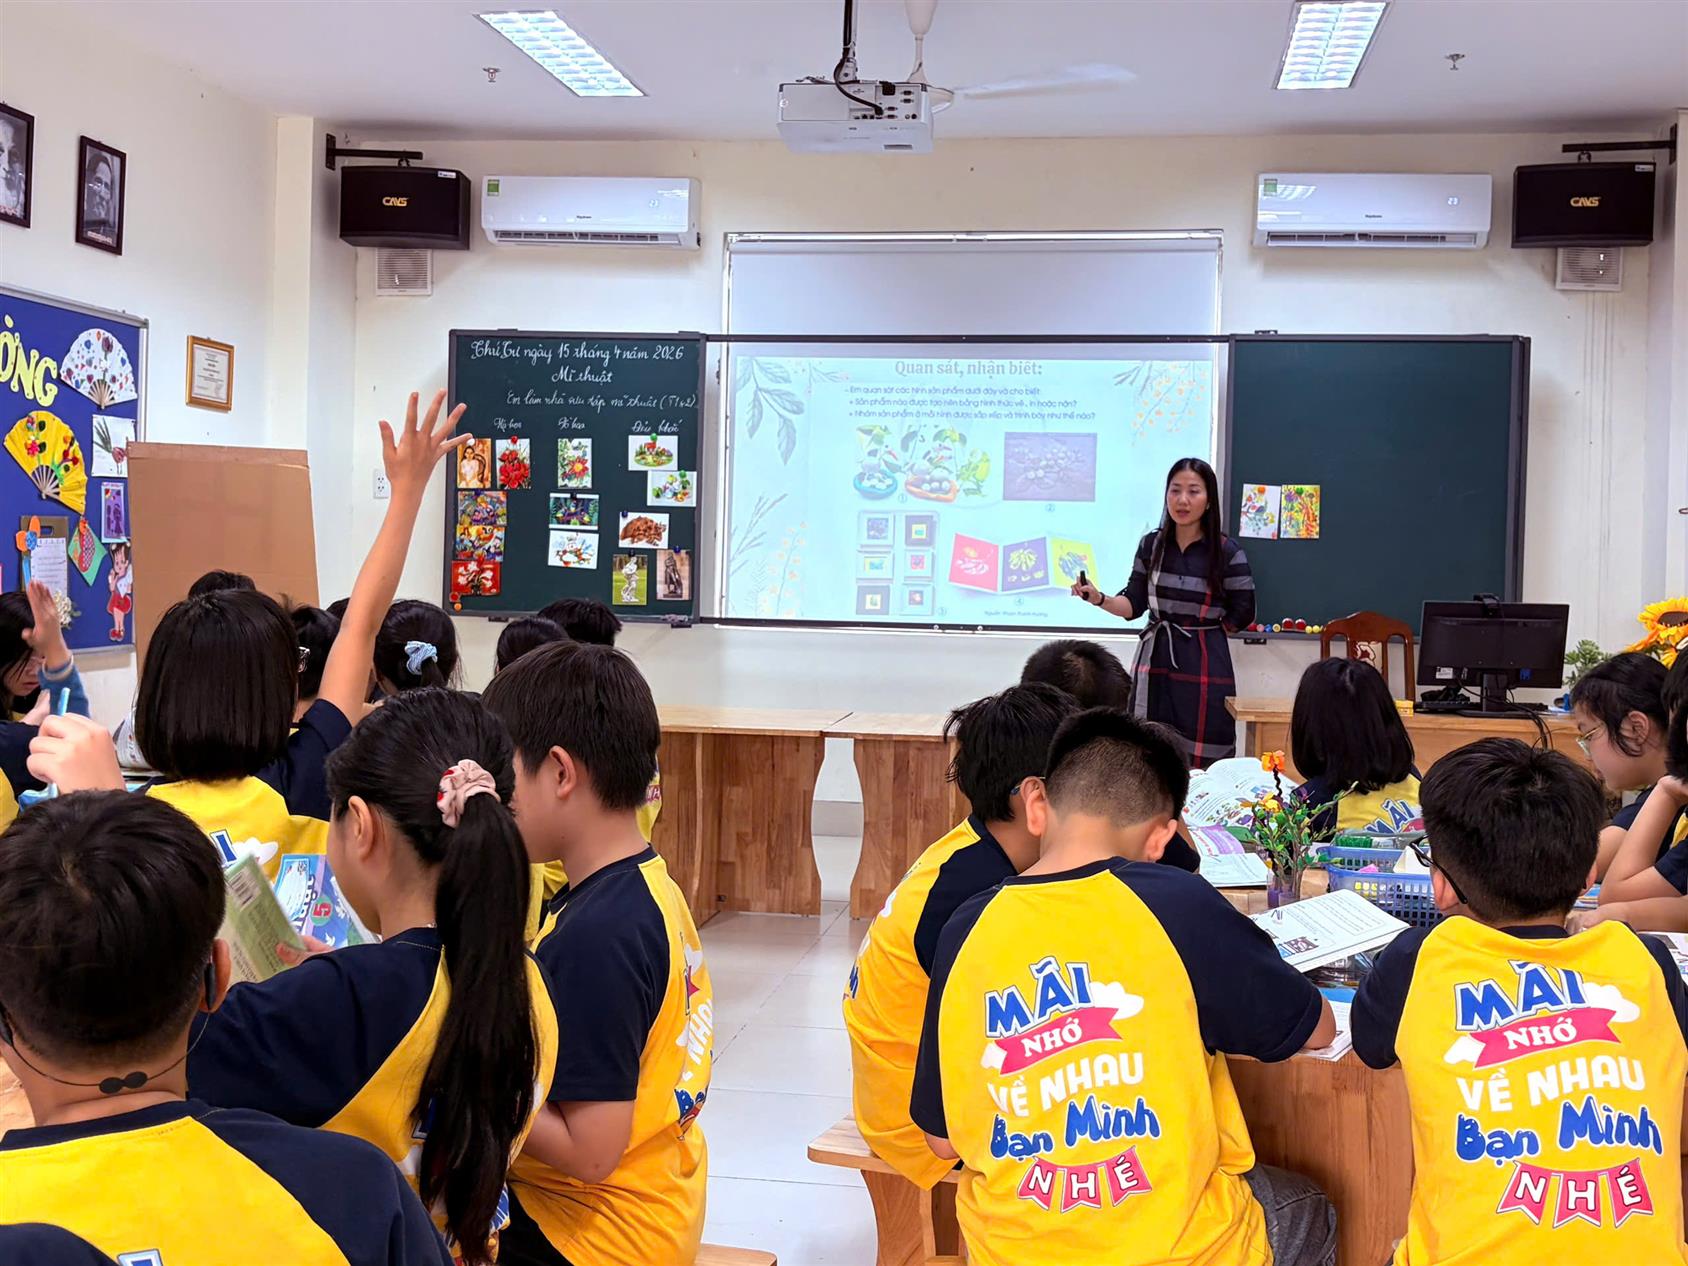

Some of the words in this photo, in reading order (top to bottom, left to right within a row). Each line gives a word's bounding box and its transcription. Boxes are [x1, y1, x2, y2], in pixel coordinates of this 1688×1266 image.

[382, 197, 408, 207] CAVS
[1570, 196, 1601, 207] CAVS
[471, 340, 501, 360] Thứ
[524, 344, 552, 366] ngày
[559, 342, 570, 359] 15
[573, 342, 610, 367] tháng
[614, 345, 622, 359] 4
[653, 345, 685, 360] 2026
[895, 361, 933, 377] Quan
[936, 359, 964, 378] sát,
[967, 360, 1005, 379] nhận
[1009, 360, 1042, 375] biết:
[575, 366, 613, 385] thuật
[313, 902, 332, 918] 5
[985, 957, 1094, 1038] MÃI
[1455, 960, 1590, 1031] MÃI
[1021, 1017, 1082, 1057] NHỚ
[1503, 1017, 1577, 1050] NHỚ
[1040, 1052, 1144, 1111] NHAU
[1456, 1068, 1513, 1112] VỀ
[1527, 1055, 1645, 1106] NHAU
[1064, 1094, 1161, 1148] Mình
[1456, 1113, 1540, 1167] Bạn
[1558, 1094, 1663, 1156] Mình
[1029, 1156, 1139, 1199] NHÉ
[1514, 1165, 1642, 1211] NHÉ
